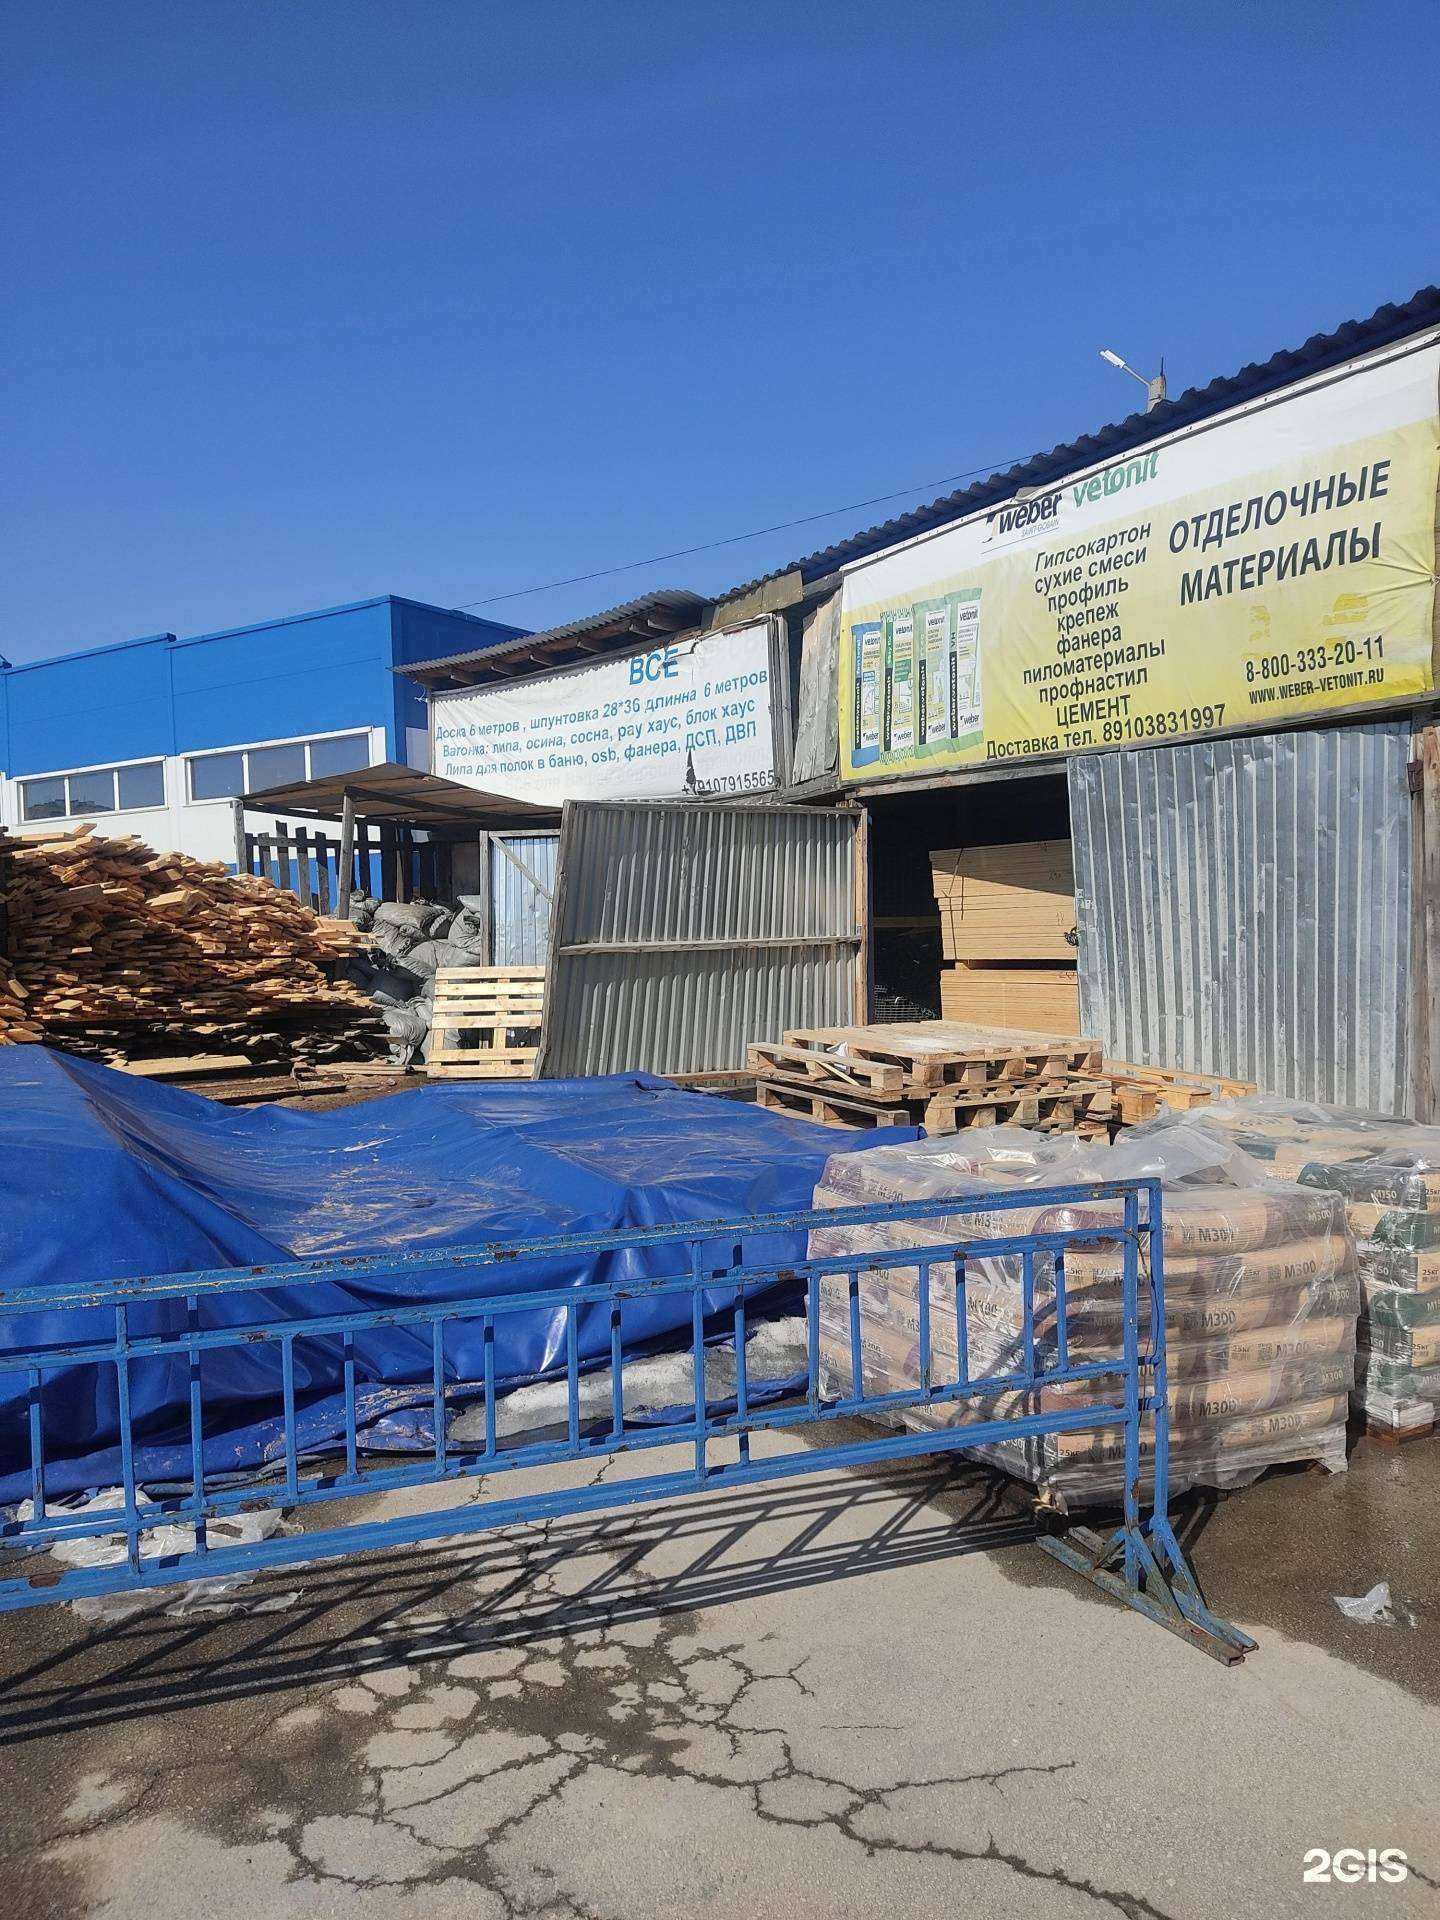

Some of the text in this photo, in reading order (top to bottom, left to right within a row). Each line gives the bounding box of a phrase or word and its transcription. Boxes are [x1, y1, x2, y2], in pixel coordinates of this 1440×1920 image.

[999, 451, 1159, 534] weber vetonit
[1169, 459, 1391, 554] ОТДЕЛОЧНЫЕ
[1035, 522, 1151, 572] Гипсокартон
[1180, 521, 1382, 606] МАТЕРИАЛЫ
[1035, 547, 1147, 596] сухие смеси
[1048, 577, 1129, 614] профиль
[1057, 601, 1119, 634] крепеж
[1023, 639, 1165, 684] пиломатериалы
[1057, 625, 1121, 658] фанера
[1246, 635, 1384, 682] 8-800-333-20-11
[630, 646, 679, 686] ВСЕ
[1039, 667, 1148, 705] профнастил
[1249, 667, 1384, 704] WWW.WEBER-VETONIT.RU
[436, 727, 466, 741] Доска
[469, 724, 476, 736] 6
[479, 721, 520, 736] метров
[530, 708, 599, 730] шпунтовка
[645, 689, 697, 713] длинна
[704, 682, 711, 697] 6
[715, 670, 768, 695] метров
[526, 736, 566, 750] осина,
[570, 727, 613, 745] сосна,
[618, 723, 642, 742] рау
[647, 716, 681, 734] хаус,
[685, 707, 717, 726] блок
[721, 699, 755, 719] хаус
[1056, 694, 1130, 728] ЦЕМЕНТ
[445, 763, 473, 776] Липа
[500, 760, 534, 773] полок
[538, 759, 545, 769] в
[549, 754, 588, 768] баню,
[591, 748, 620, 764] osb,
[624, 739, 681, 762] фанера,
[685, 729, 721, 751] ДСП,
[725, 721, 757, 745] ДВП
[986, 703, 1226, 760] Доставка тел. 89103831997
[1200, 1311, 1236, 1328] М300
[1199, 1400, 1237, 1417] М300
